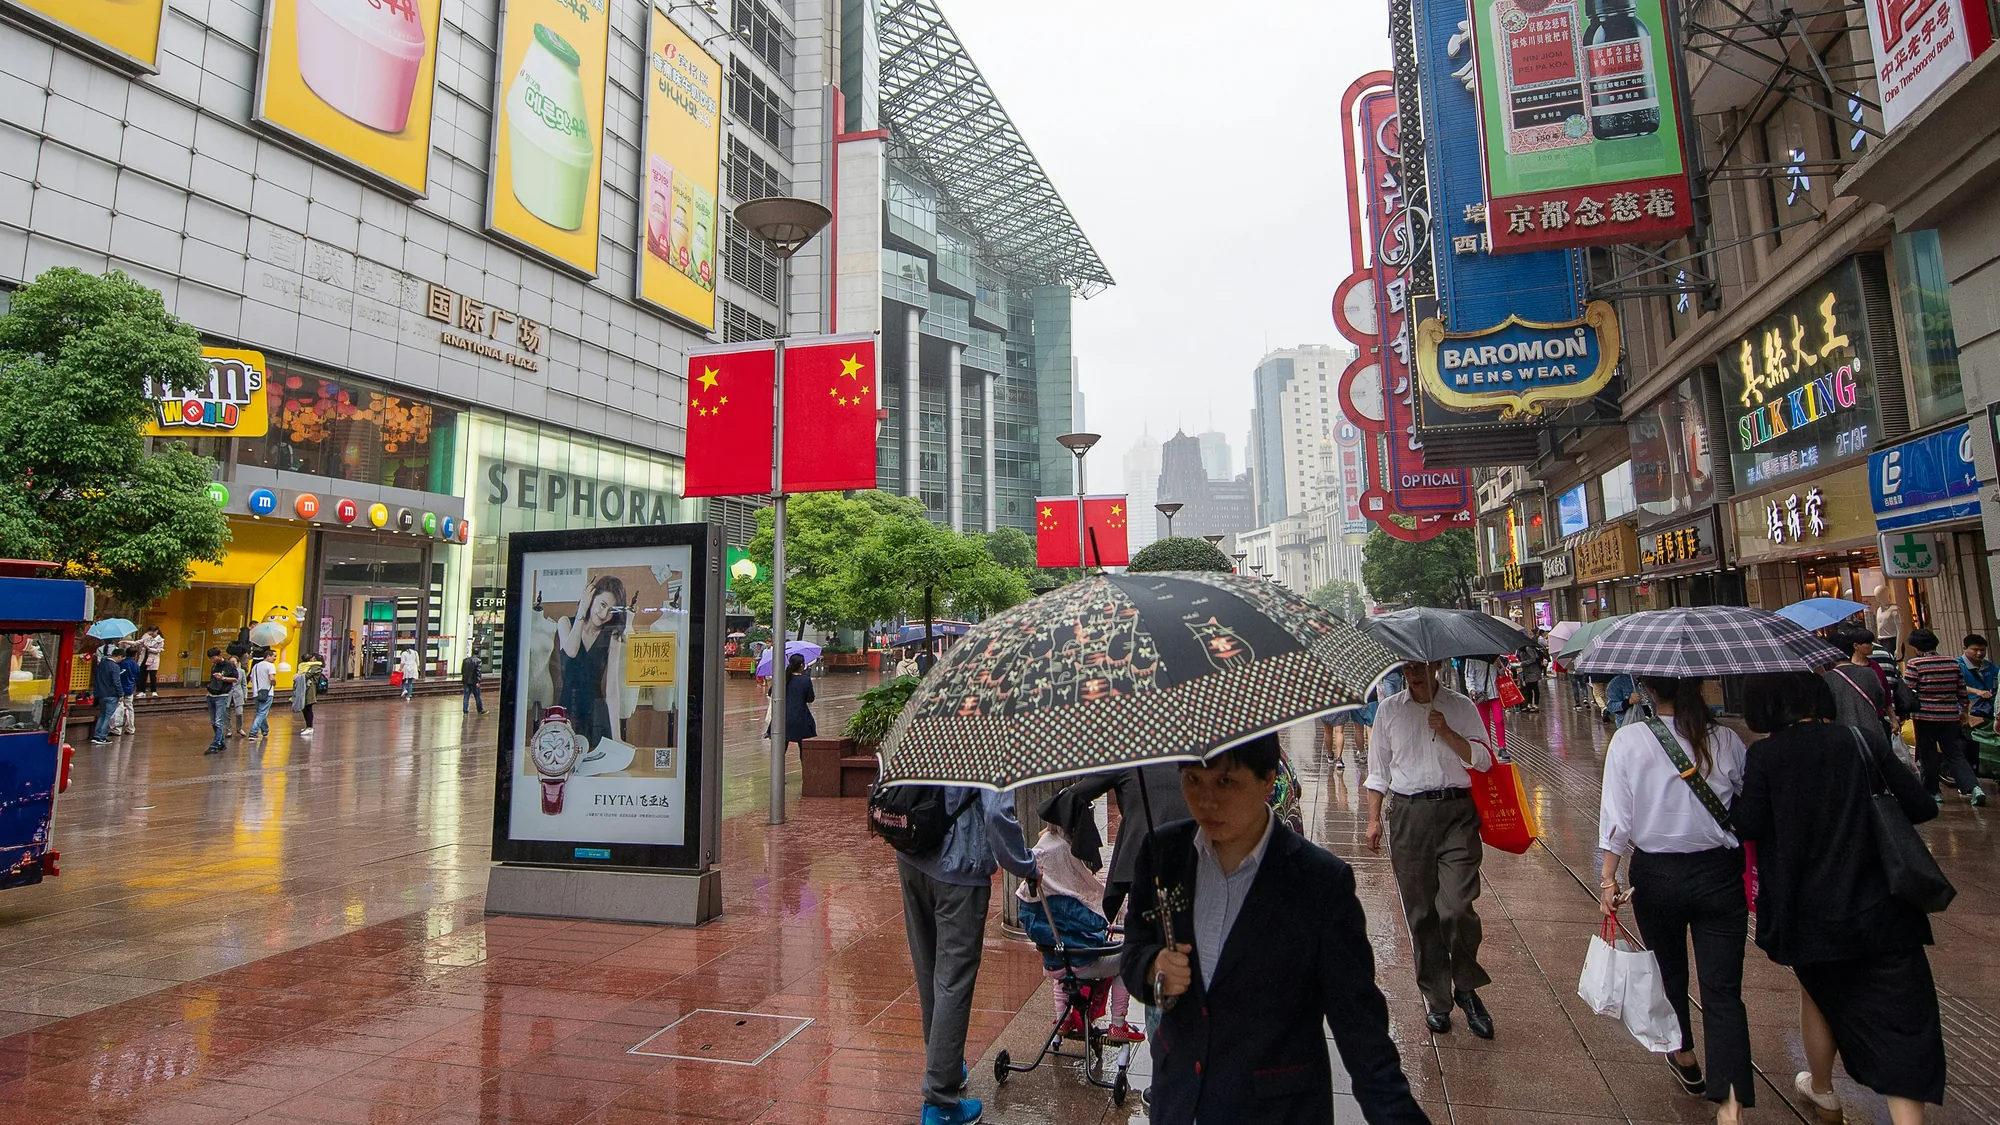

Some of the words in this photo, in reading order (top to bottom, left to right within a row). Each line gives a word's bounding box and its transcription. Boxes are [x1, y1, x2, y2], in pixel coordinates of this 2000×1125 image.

[1522, 54, 1539, 63] NIN
[1541, 51, 1563, 61] JIOM
[1881, 2, 1950, 84] 中华老字号
[1518, 66, 1534, 74] PEI
[1536, 64, 1548, 72] PA
[1549, 61, 1569, 70] KOA
[1884, 85, 1900, 104] China
[1899, 45, 1936, 89] Time-honored
[1936, 27, 1955, 55] Brand
[652, 51, 717, 117] 香蕉味牛奶饮料
[1504, 188, 1676, 236] 京都念慈菴
[427, 283, 542, 353] 国际广场
[506, 352, 539, 373] PLAZA
[1443, 336, 1587, 370] BAROMON
[1456, 370, 1513, 385] MENS
[1518, 364, 1578, 379] WEAR
[1738, 397, 1788, 451] SILK
[1788, 364, 1857, 430] KING
[1836, 424, 1868, 457] 2F/3F
[488, 463, 667, 525] SEPHORA
[1402, 472, 1459, 488] OPTICAL
[634, 641, 671, 658] 执为所爱
[594, 794, 634, 806] FIYTA
[639, 794, 669, 808] 飞亚达
